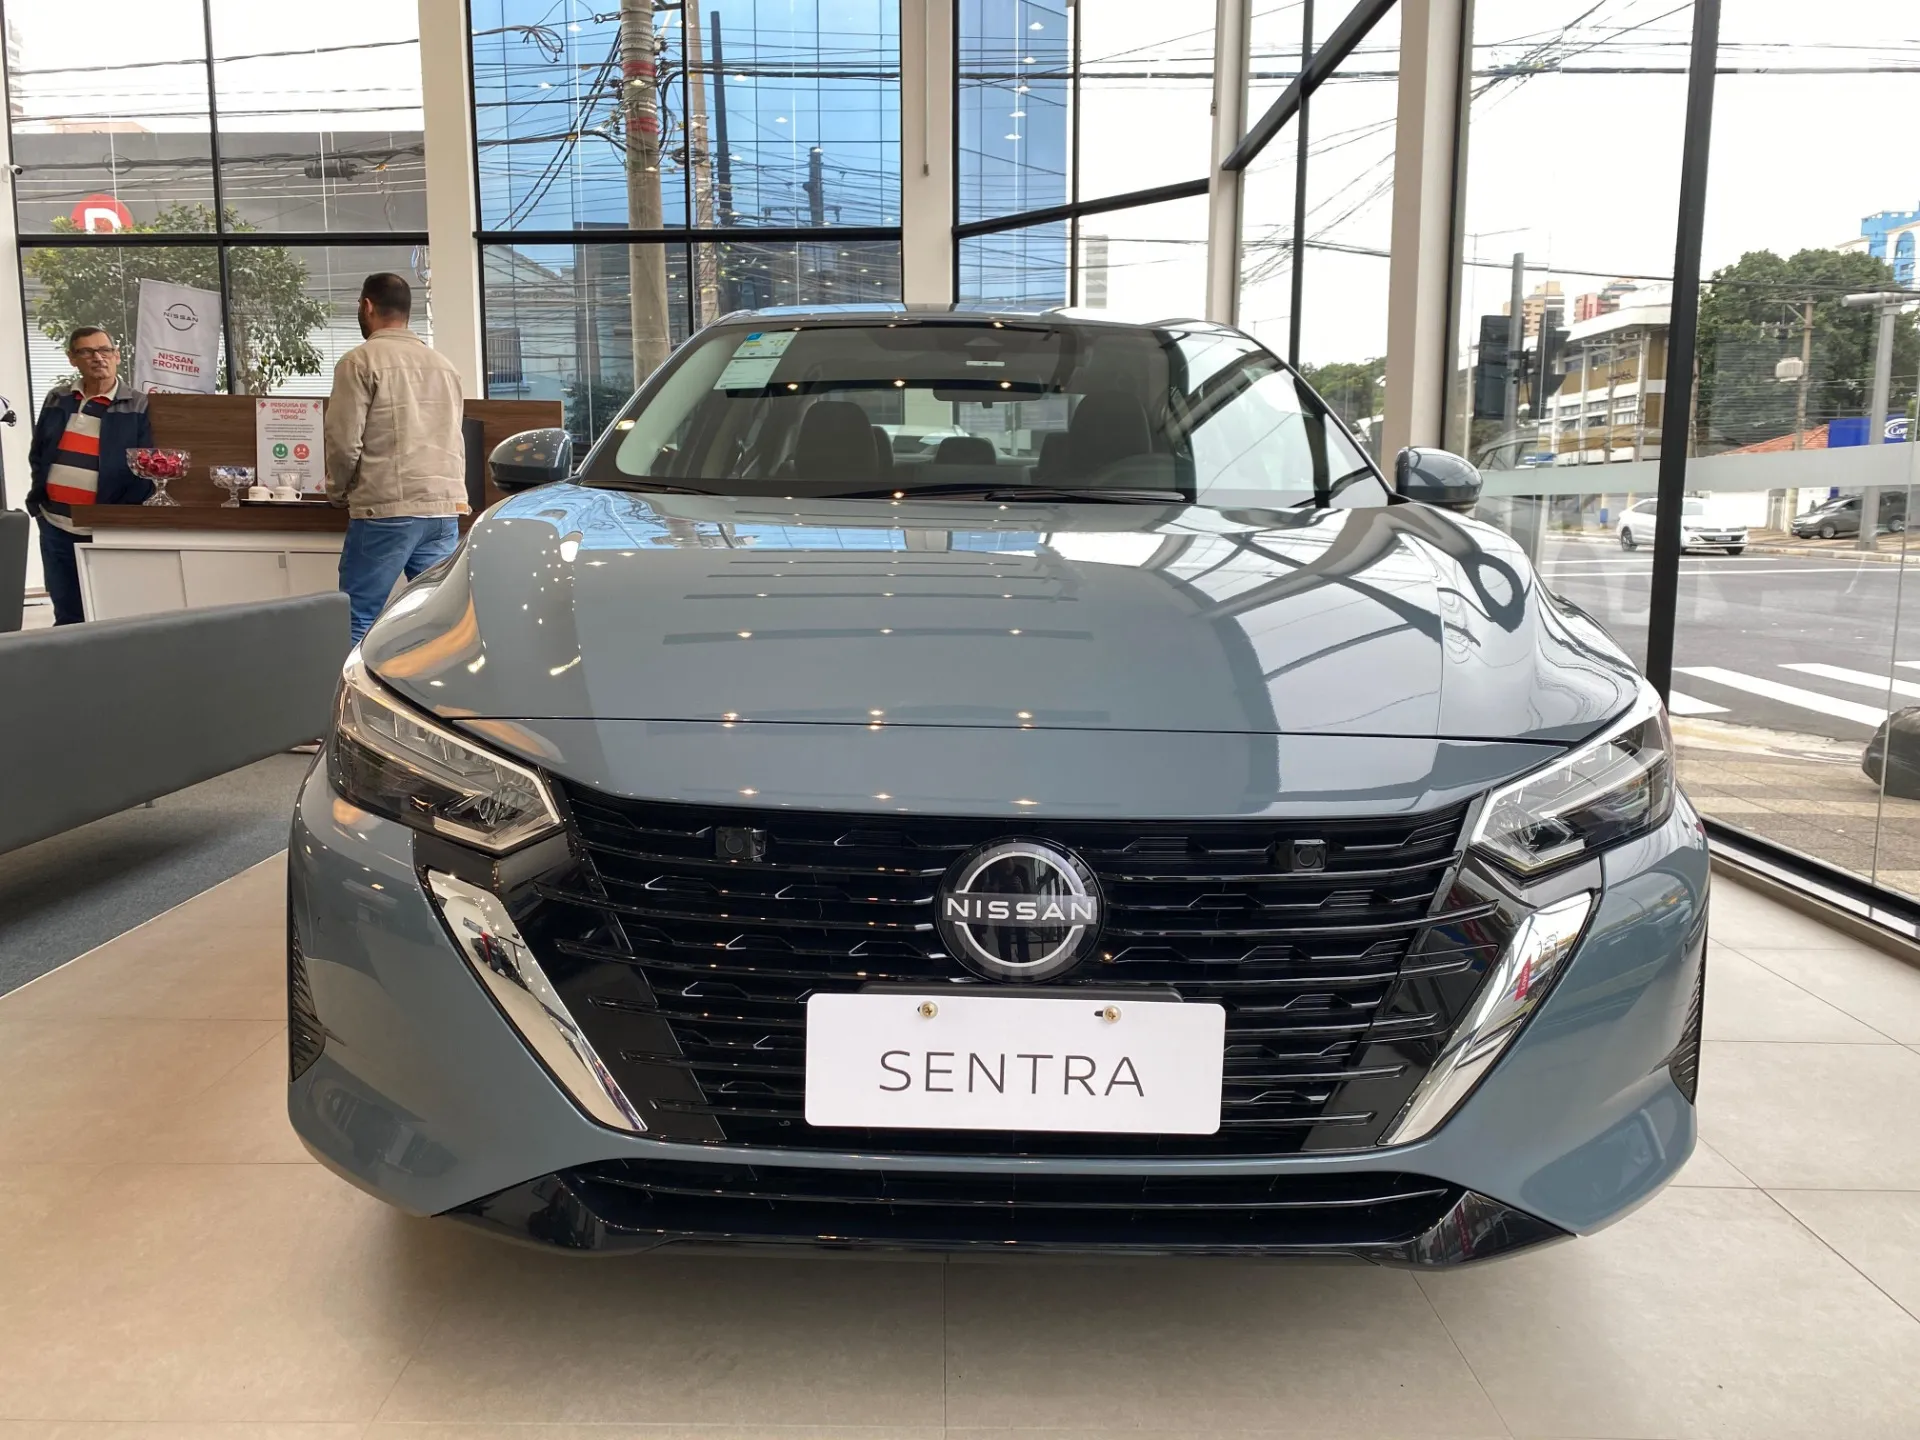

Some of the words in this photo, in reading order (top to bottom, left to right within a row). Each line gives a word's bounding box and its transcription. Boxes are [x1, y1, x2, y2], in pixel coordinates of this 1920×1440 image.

[163, 311, 199, 322] NISSAN
[158, 352, 194, 365] NISSAN
[152, 359, 200, 373] FRONTIER
[947, 897, 1092, 920] NISSAN
[879, 1050, 1145, 1097] SENTRA
